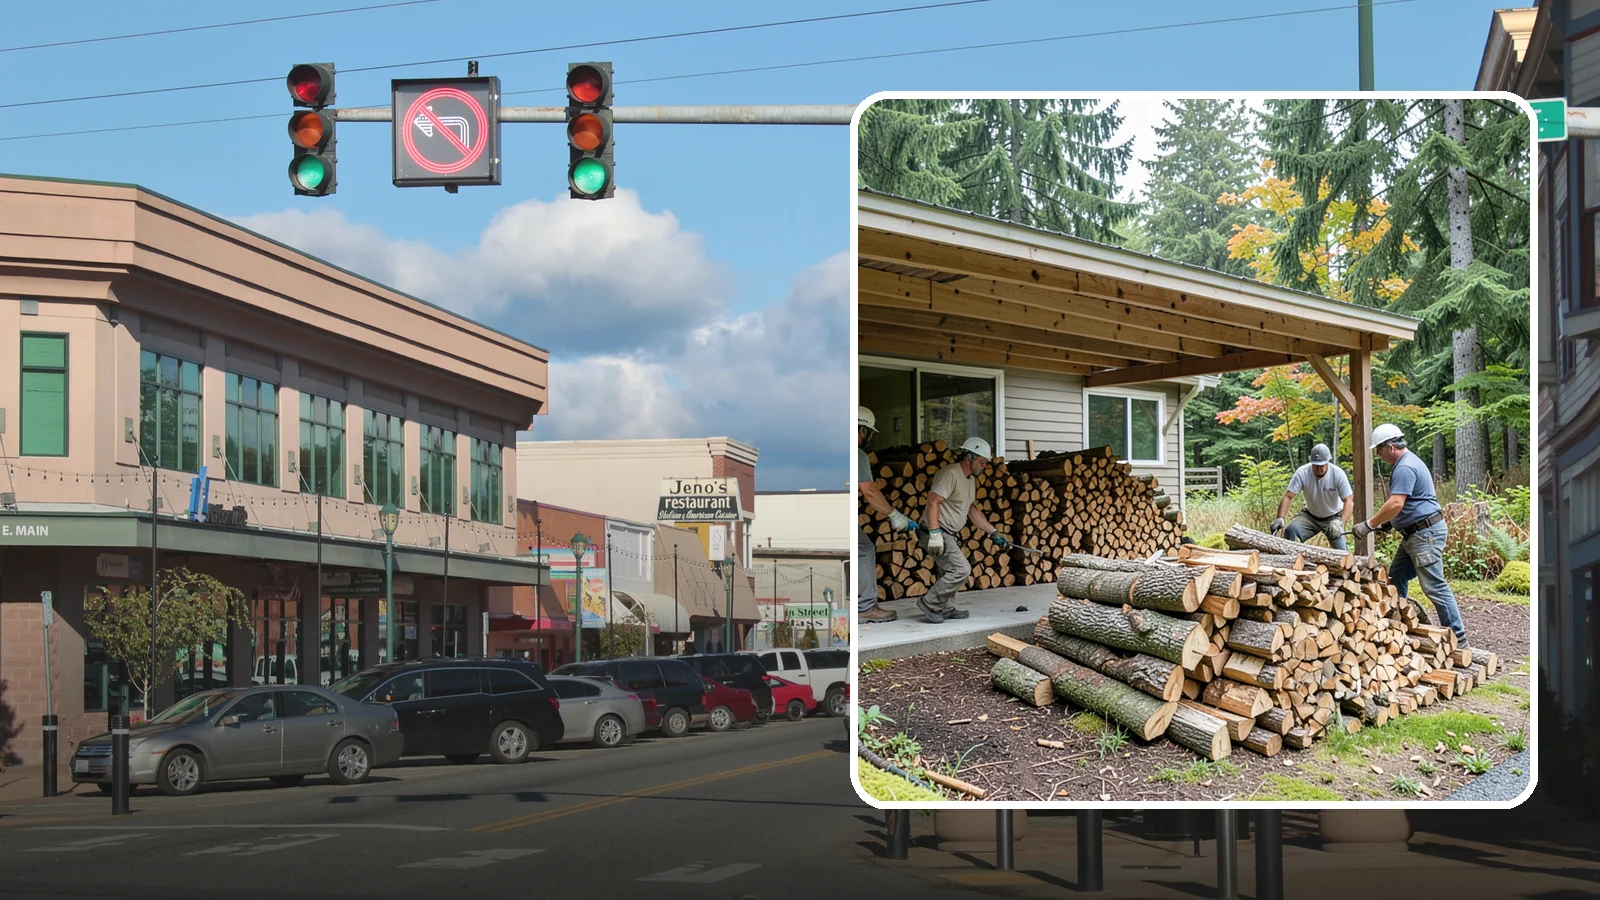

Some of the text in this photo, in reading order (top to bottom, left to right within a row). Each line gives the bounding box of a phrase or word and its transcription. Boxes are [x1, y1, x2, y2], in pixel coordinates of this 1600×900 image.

[670, 480, 728, 495] Jeno's
[665, 496, 731, 509] restaurant
[658, 509, 682, 520] Italian
[686, 509, 715, 520] American
[715, 509, 738, 520] Cuisine
[2, 525, 49, 536] E. MAIN
[797, 607, 828, 617] Street
[790, 619, 824, 627] lass
